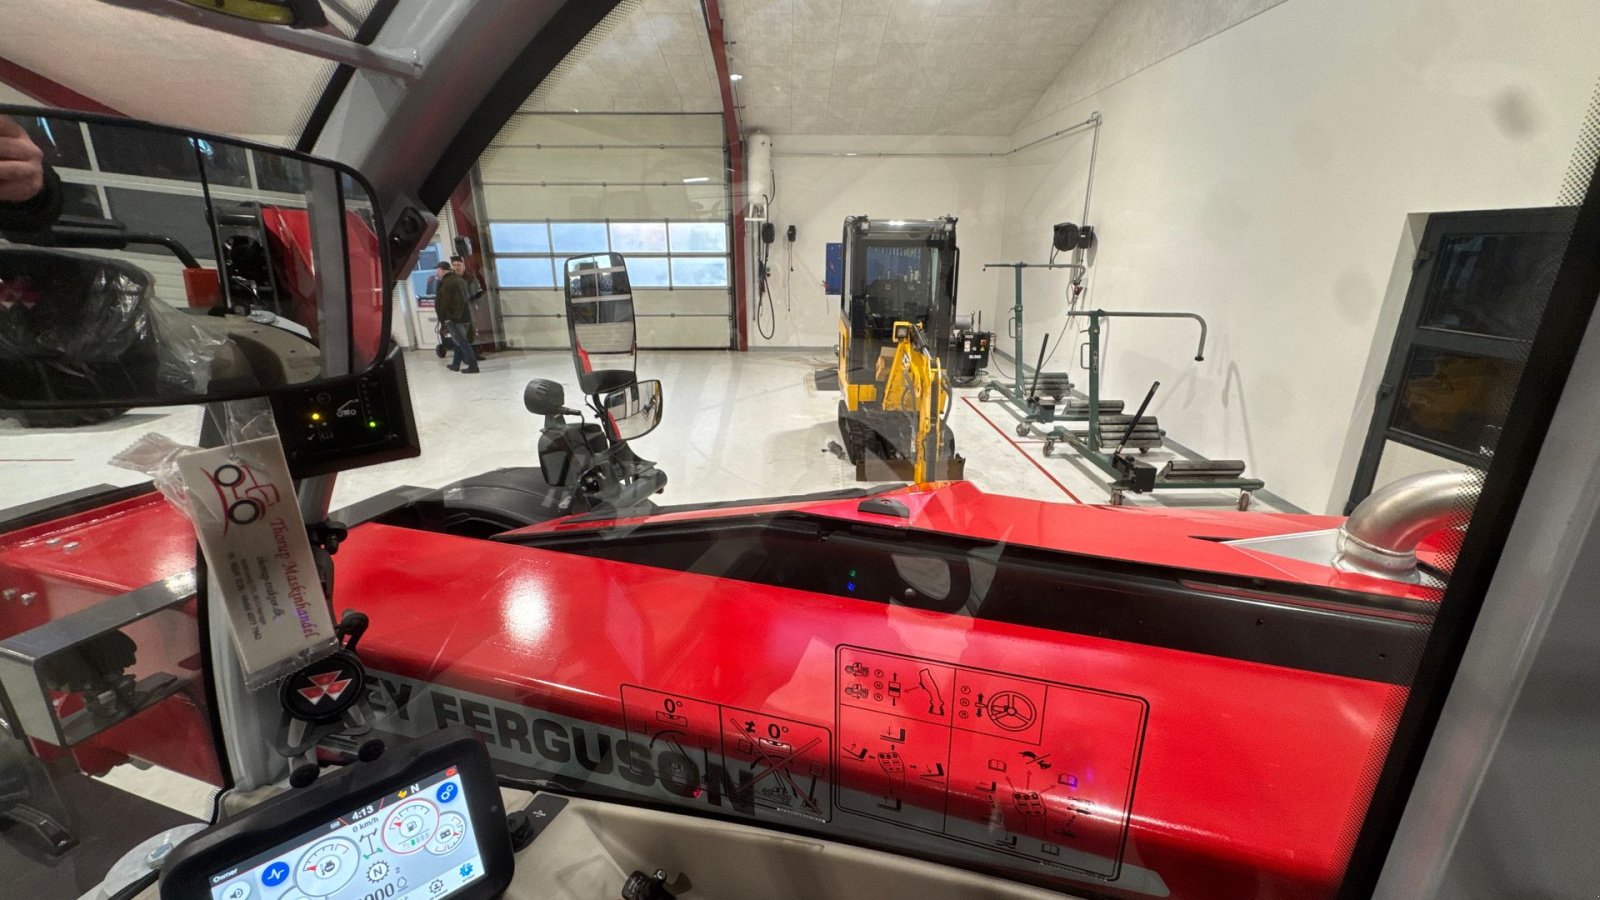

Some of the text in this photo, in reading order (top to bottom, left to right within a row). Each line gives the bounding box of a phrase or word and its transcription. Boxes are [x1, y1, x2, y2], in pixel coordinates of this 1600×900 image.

[271, 518, 321, 639] Thorup Maskinhandel
[429, 690, 756, 816] FERGUSON
[410, 783, 420, 794] N
[351, 804, 374, 820] 4:13
[213, 868, 238, 883] Owner
[372, 865, 383, 878] N
